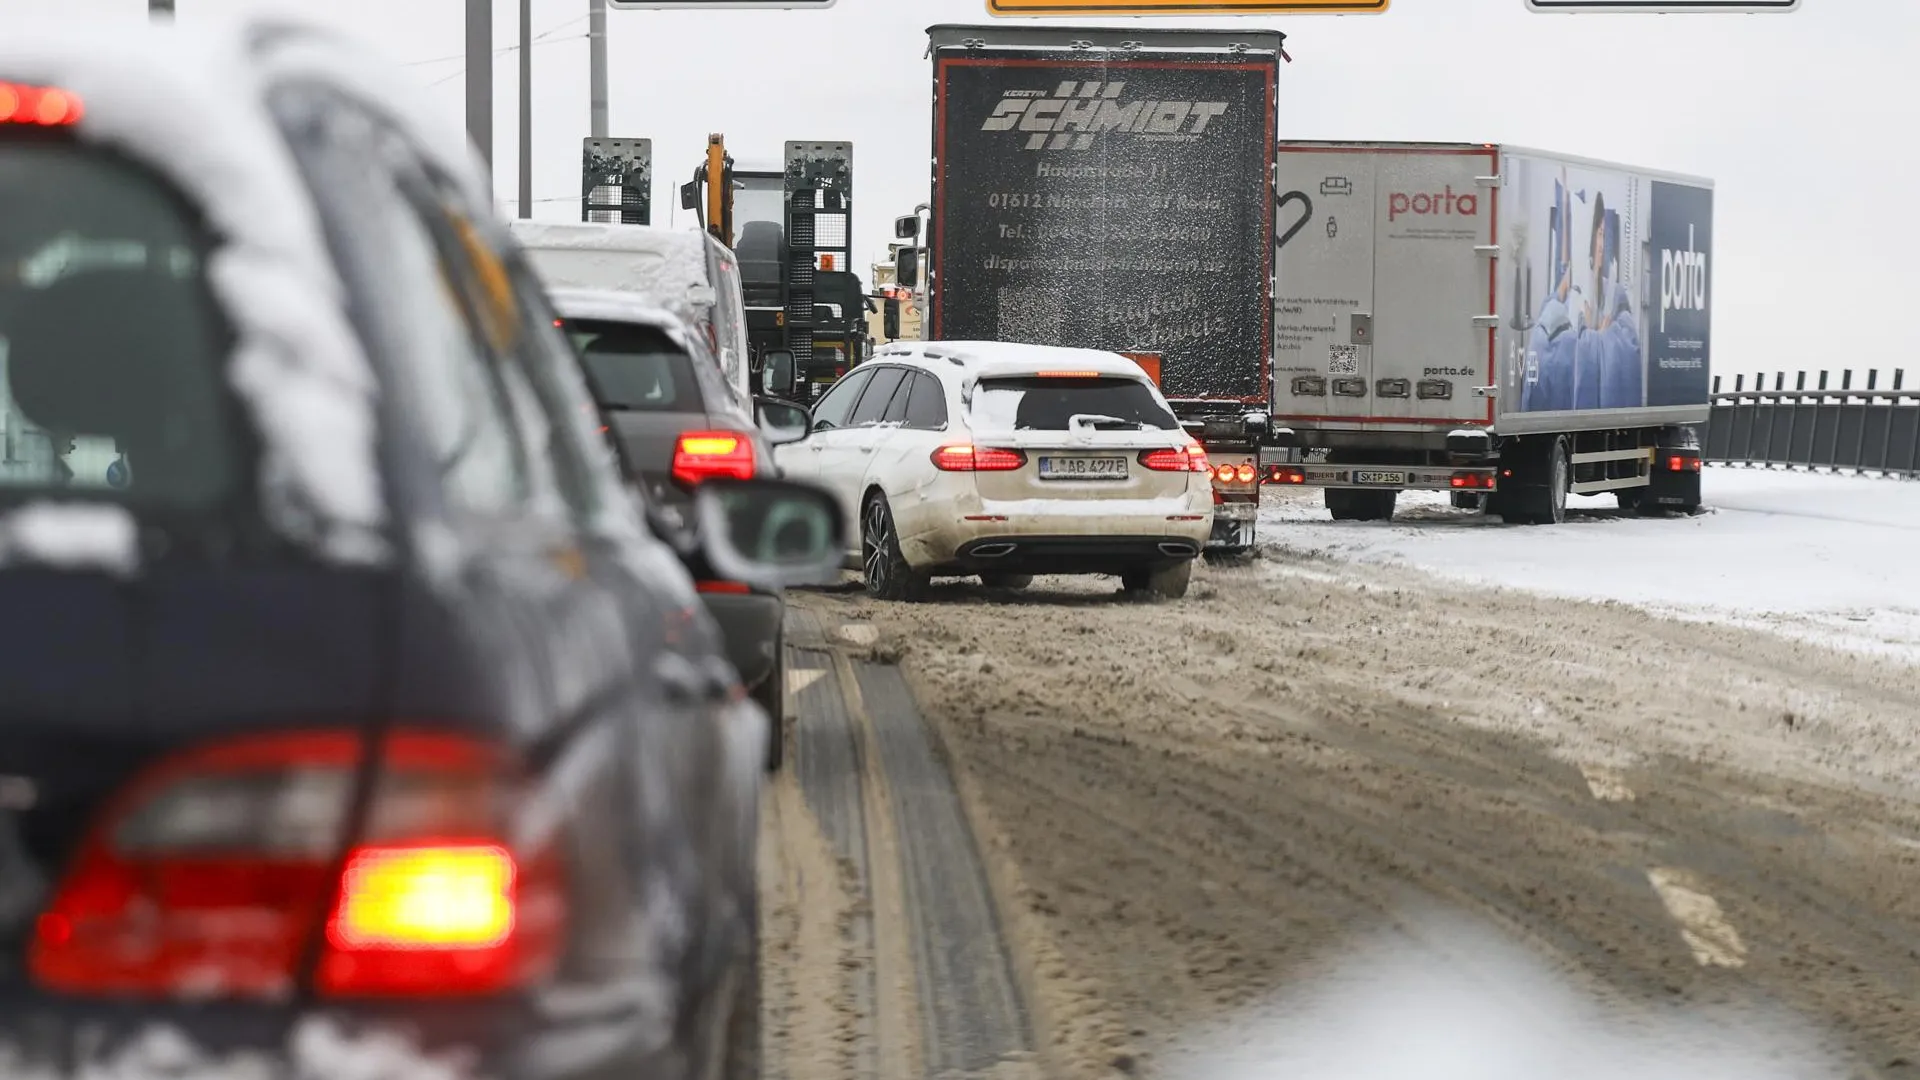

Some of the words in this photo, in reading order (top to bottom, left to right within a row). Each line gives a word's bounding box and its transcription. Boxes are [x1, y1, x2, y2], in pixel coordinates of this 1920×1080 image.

[981, 99, 1230, 133] SCHMIDT
[987, 192, 1043, 208] 01612
[1389, 184, 1478, 222] porta
[1660, 223, 1706, 333] porta
[1423, 366, 1475, 378] porta.de
